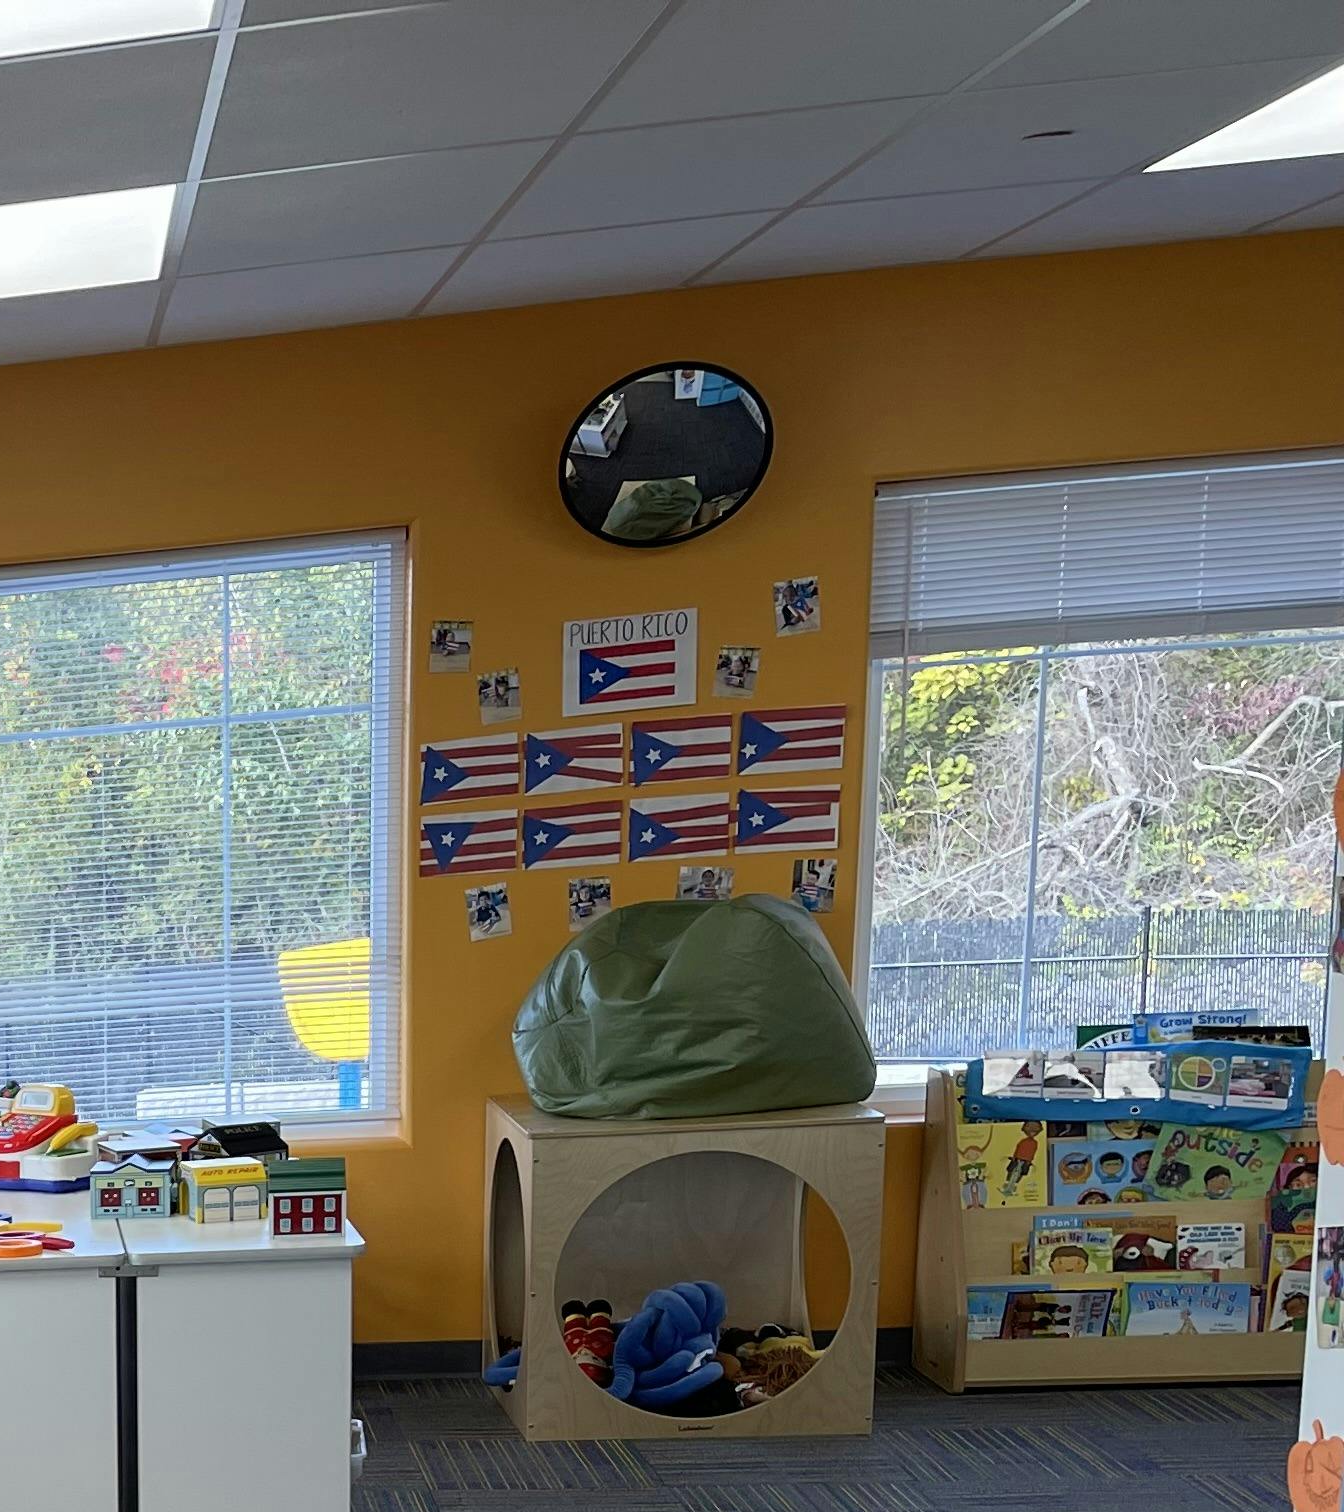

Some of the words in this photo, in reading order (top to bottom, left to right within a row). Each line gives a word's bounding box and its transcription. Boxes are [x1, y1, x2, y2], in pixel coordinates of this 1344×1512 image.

[569, 618, 634, 647] PUERTO
[642, 611, 688, 639] RICO
[1159, 1017, 1193, 1029] Grow
[1197, 1014, 1247, 1026] Strong!
[200, 1168, 224, 1176] AUTO
[1049, 1217, 1079, 1228] Don't
